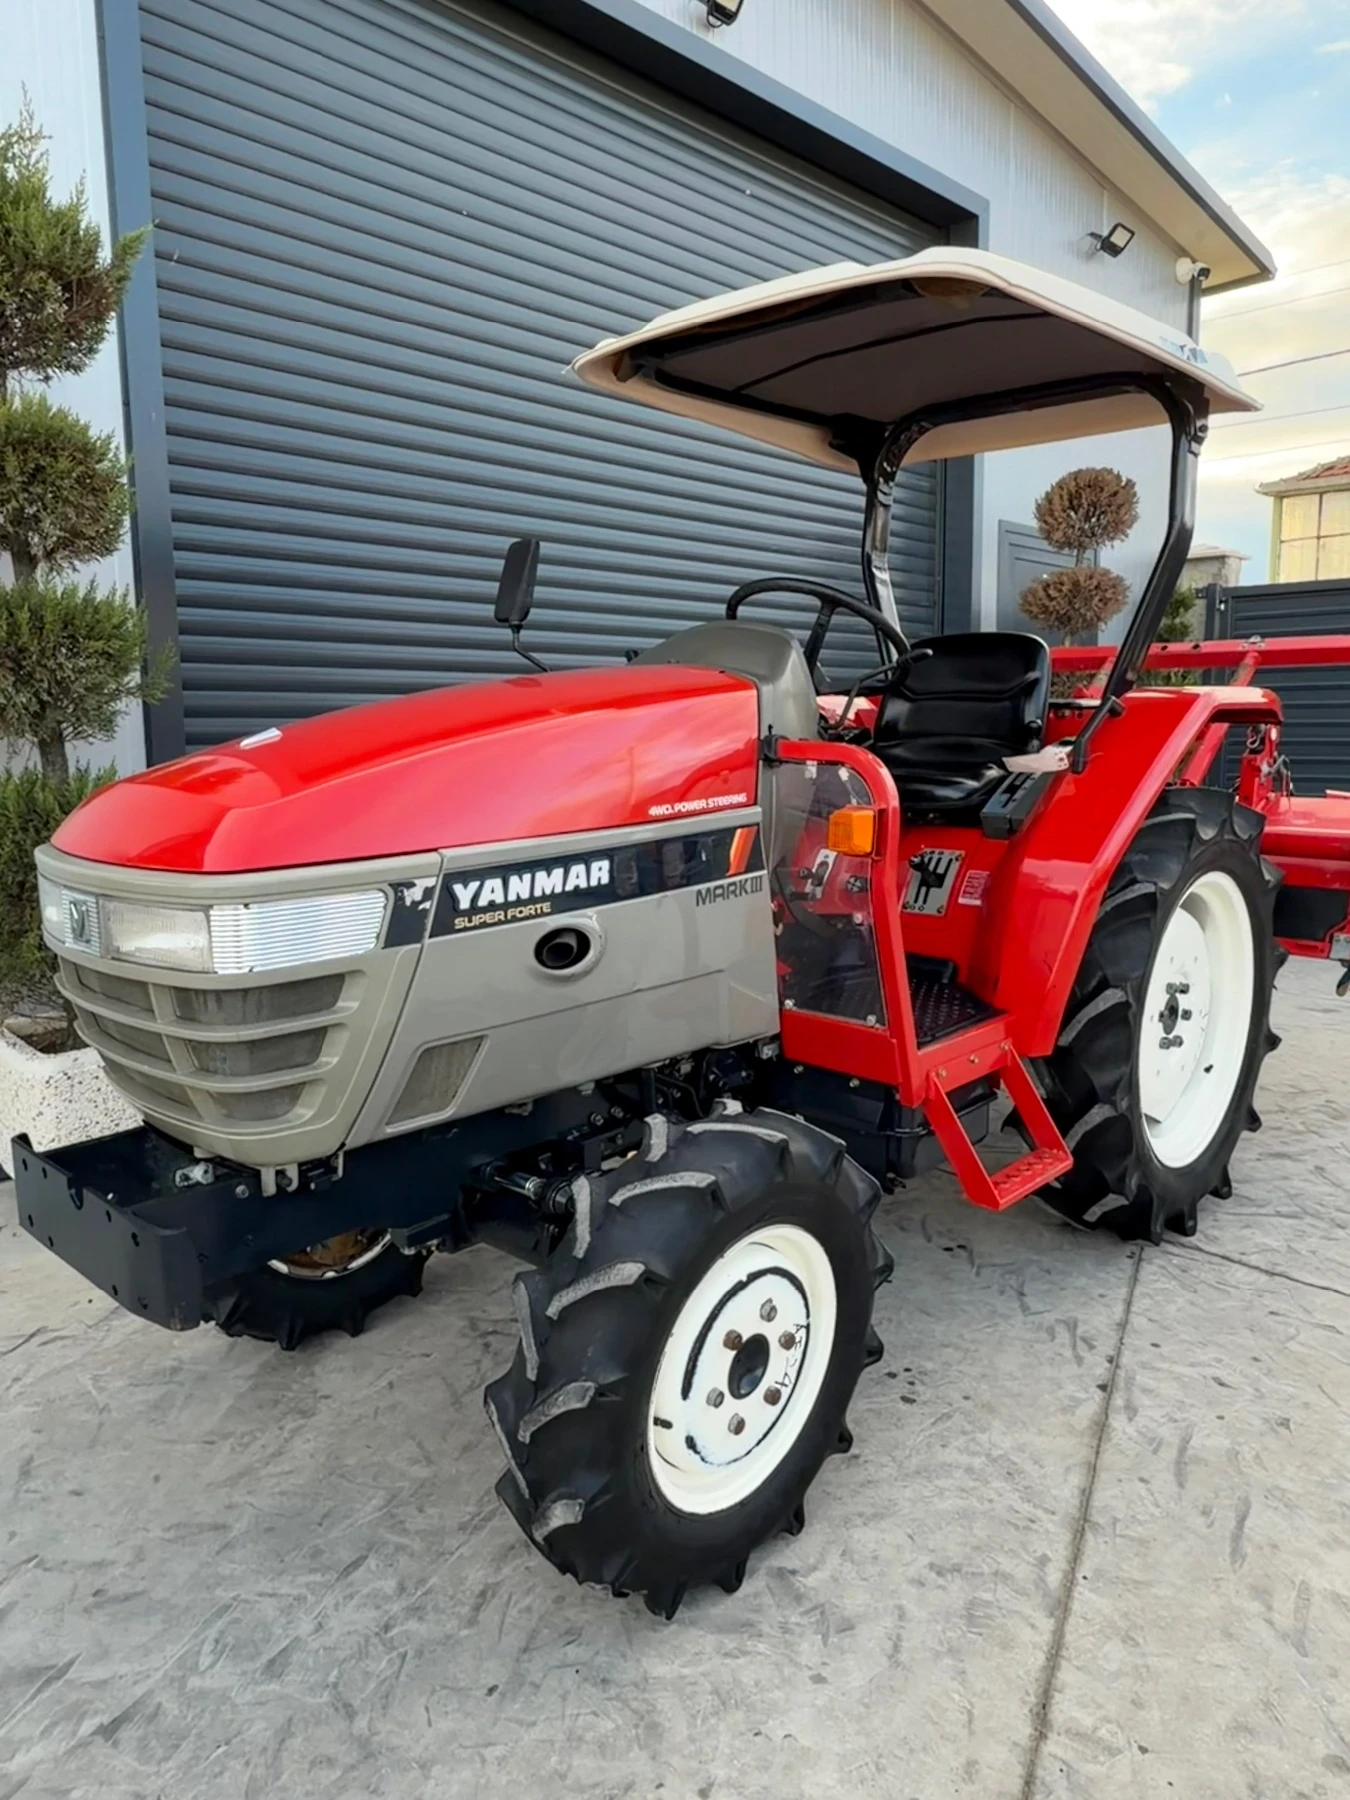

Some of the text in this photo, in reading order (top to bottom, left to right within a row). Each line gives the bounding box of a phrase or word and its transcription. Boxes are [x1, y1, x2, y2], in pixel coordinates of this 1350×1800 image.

[674, 798, 708, 813] POWER
[707, 792, 748, 809] STEERING
[452, 859, 611, 911] YANMAR
[454, 902, 552, 930] SUPER FORTE
